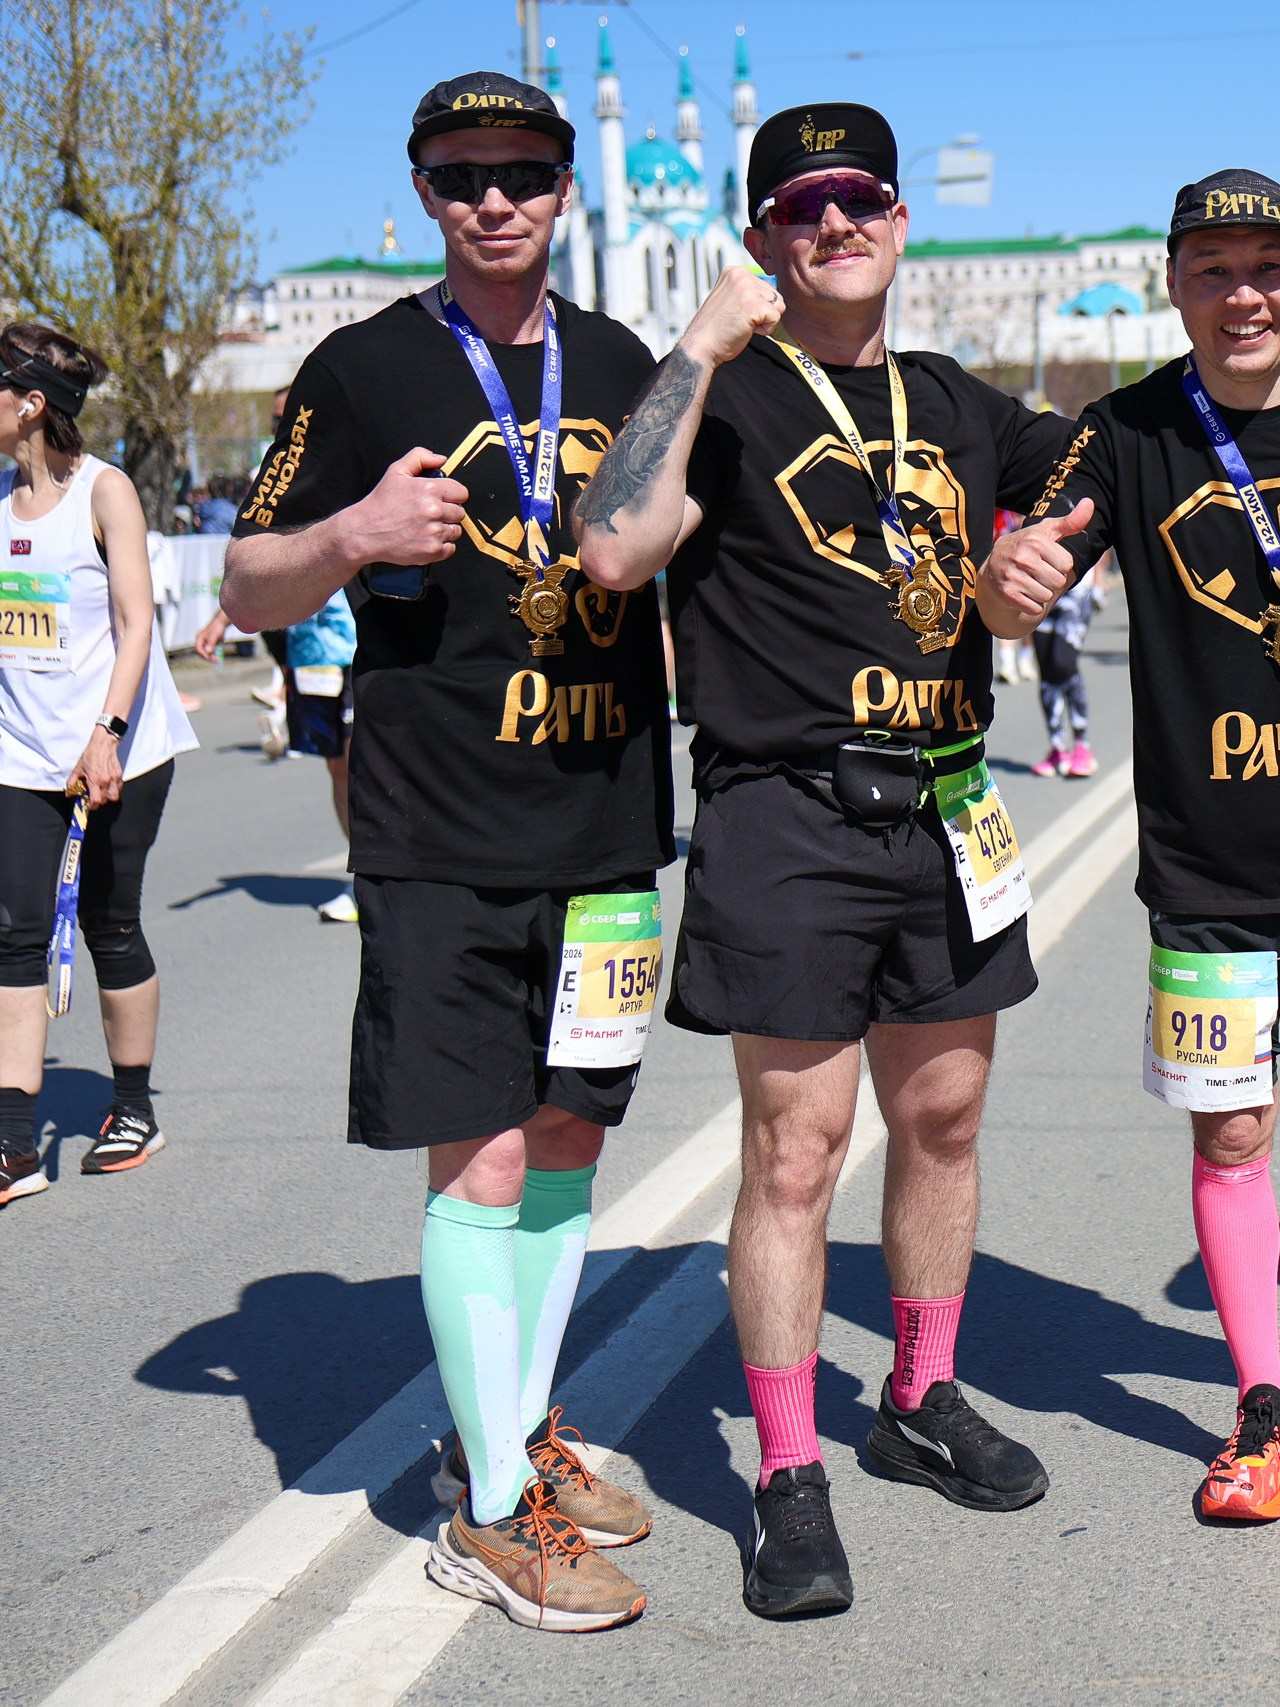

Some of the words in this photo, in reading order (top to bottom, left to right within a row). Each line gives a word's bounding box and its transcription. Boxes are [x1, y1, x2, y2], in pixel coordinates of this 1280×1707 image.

[815, 128, 846, 151] RP
[464, 334, 489, 368] МАГНИТ
[550, 350, 558, 372] СБЕР
[795, 352, 824, 387] 2026
[1205, 413, 1220, 433] СБЕР
[255, 507, 274, 528] В
[267, 404, 314, 507] ЛЮДЯХ
[537, 462, 552, 496] 42.2
[1255, 513, 1275, 546] 42.2
[0, 610, 50, 637] 2111
[59, 636, 68, 650] E
[973, 807, 1013, 860] 4732
[955, 843, 966, 865] E
[988, 884, 1009, 904] МАГНИТ
[591, 914, 617, 924] СБЕР
[563, 949, 583, 959] 2026
[562, 970, 577, 992] E
[604, 955, 656, 999] 1554
[1154, 965, 1172, 976] СБЕР
[618, 1000, 643, 1014] АРТУР
[585, 1029, 624, 1039] МАГНИТ
[1171, 1010, 1228, 1052] 918
[1176, 1050, 1218, 1065] РУСЛАН
[1156, 1067, 1188, 1083] МАГНИТ
